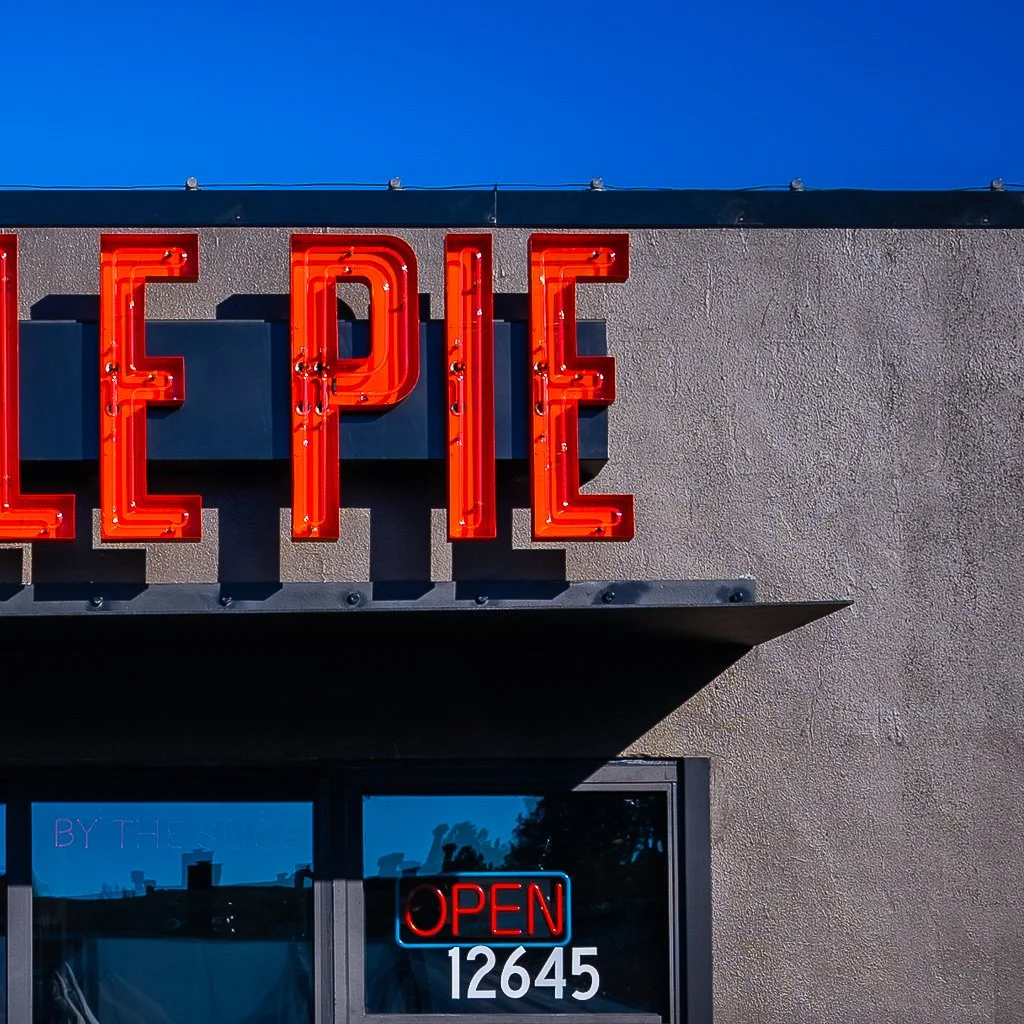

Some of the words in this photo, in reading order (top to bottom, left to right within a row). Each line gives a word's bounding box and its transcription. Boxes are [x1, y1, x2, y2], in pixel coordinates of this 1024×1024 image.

[290, 233, 634, 542] PIE
[54, 817, 98, 849] BY
[112, 818, 185, 849] THE
[405, 882, 564, 937] OPEN
[448, 945, 600, 1001] 12645
